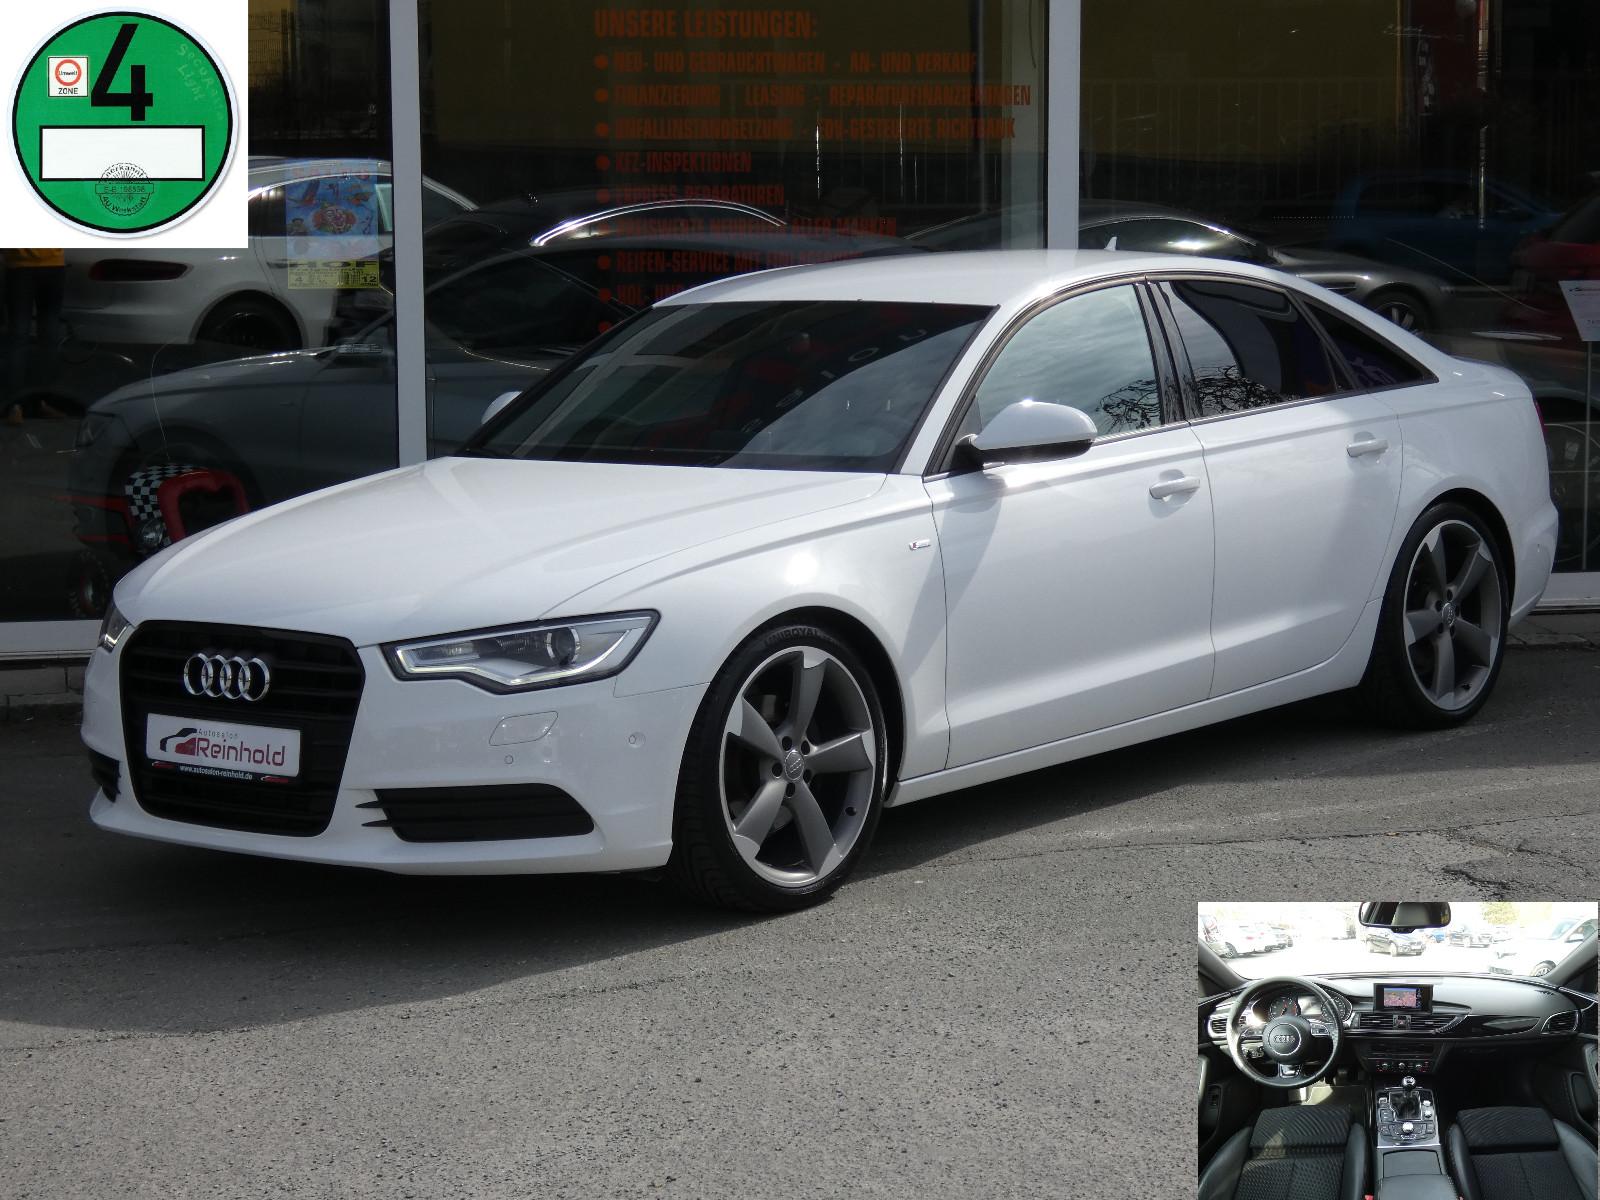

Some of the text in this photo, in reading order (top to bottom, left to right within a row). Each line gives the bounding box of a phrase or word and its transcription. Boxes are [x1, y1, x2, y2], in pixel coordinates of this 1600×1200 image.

[593, 9, 818, 39] UNSERE LEISTUNGEN:
[654, 51, 684, 73] UND
[689, 51, 826, 73] GEBRAUCHTWAGEN
[880, 51, 912, 73] UND
[916, 51, 977, 73] VERKAUF
[614, 84, 720, 106] FINANZIERUNG
[745, 84, 806, 106] LEASING
[829, 84, 1031, 107] REPARATURFINANZIERUNGEN
[615, 151, 752, 173] KFZ-INSPEKTIONEN
[615, 251, 730, 273] REIFEN-SERVICE
[196, 737, 286, 767] Reinhold
